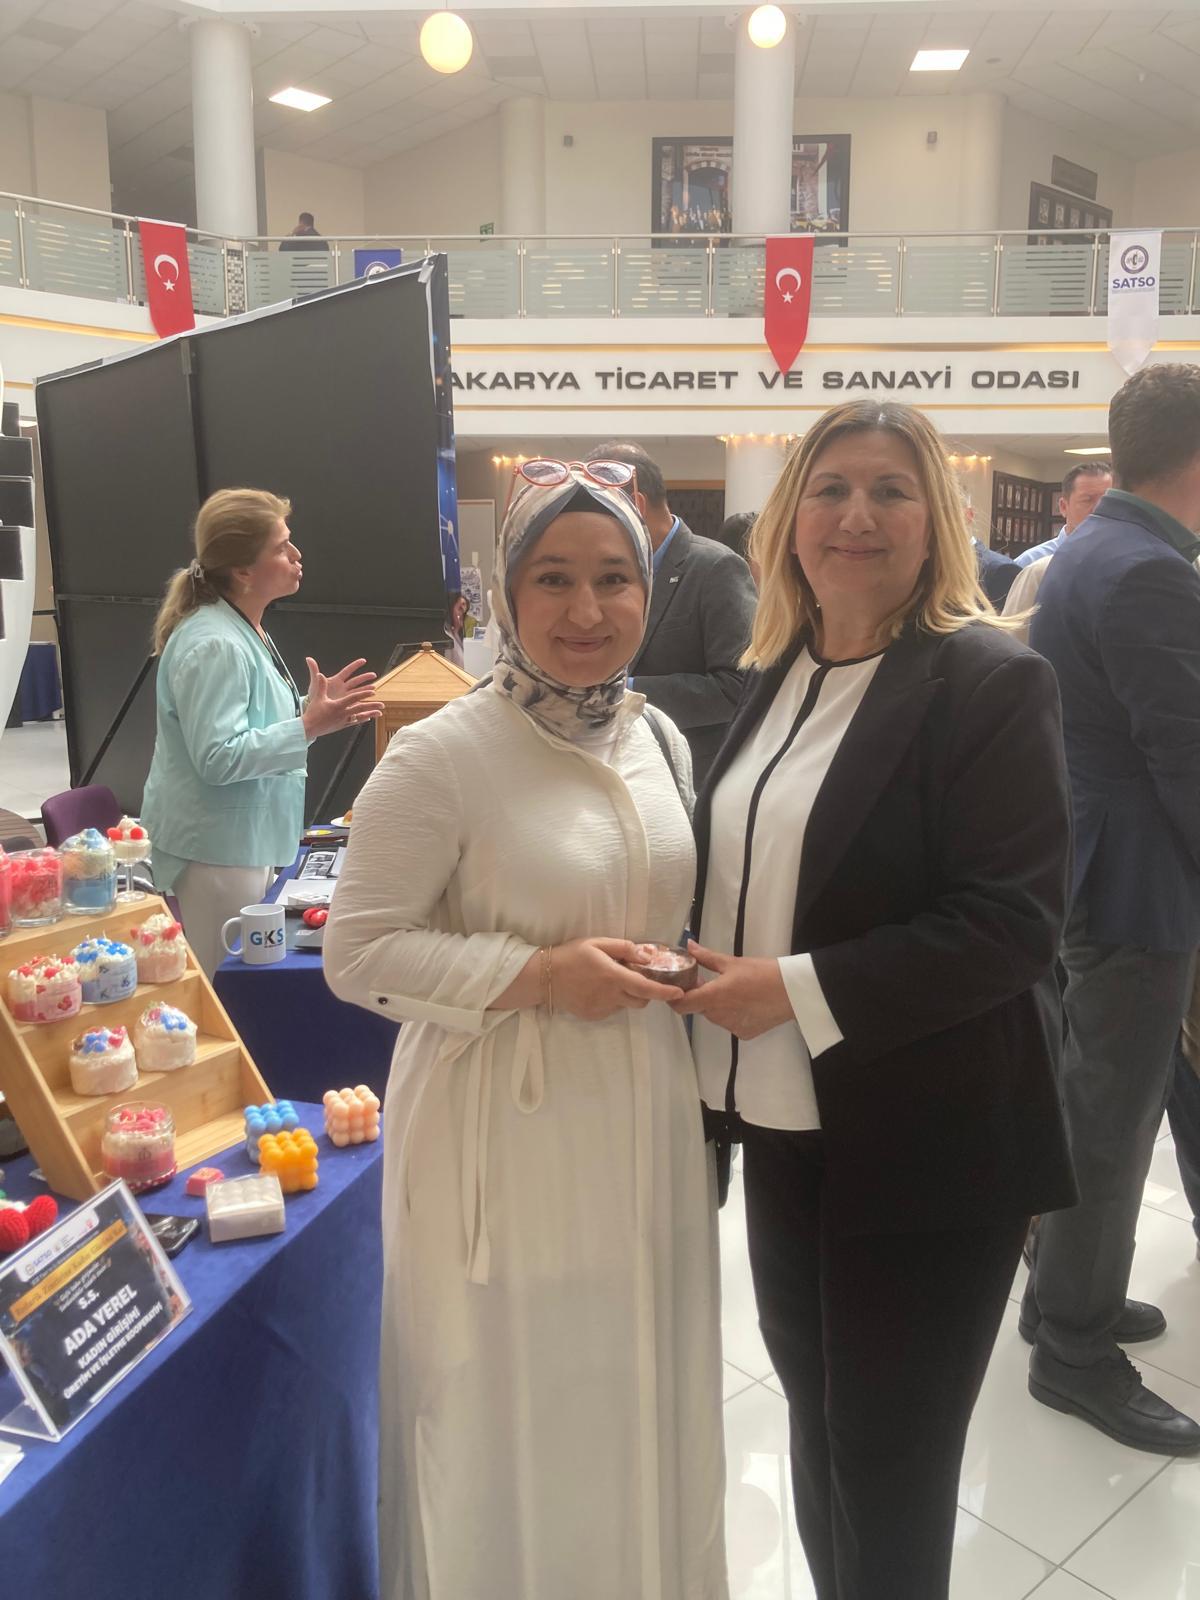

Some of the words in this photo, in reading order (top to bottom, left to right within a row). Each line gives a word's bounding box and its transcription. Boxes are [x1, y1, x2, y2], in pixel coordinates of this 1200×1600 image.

[1112, 276, 1156, 289] SATSO
[595, 367, 738, 390] TİCARET
[758, 370, 803, 389] VE
[822, 366, 951, 389] SANAYİ
[971, 370, 1079, 389] ODASI
[250, 927, 284, 946] GKS
[78, 1290, 99, 1309] S.S.
[64, 1320, 97, 1356] ADA
[93, 1284, 137, 1326] YEREL
[78, 1338, 107, 1369] KADIN
